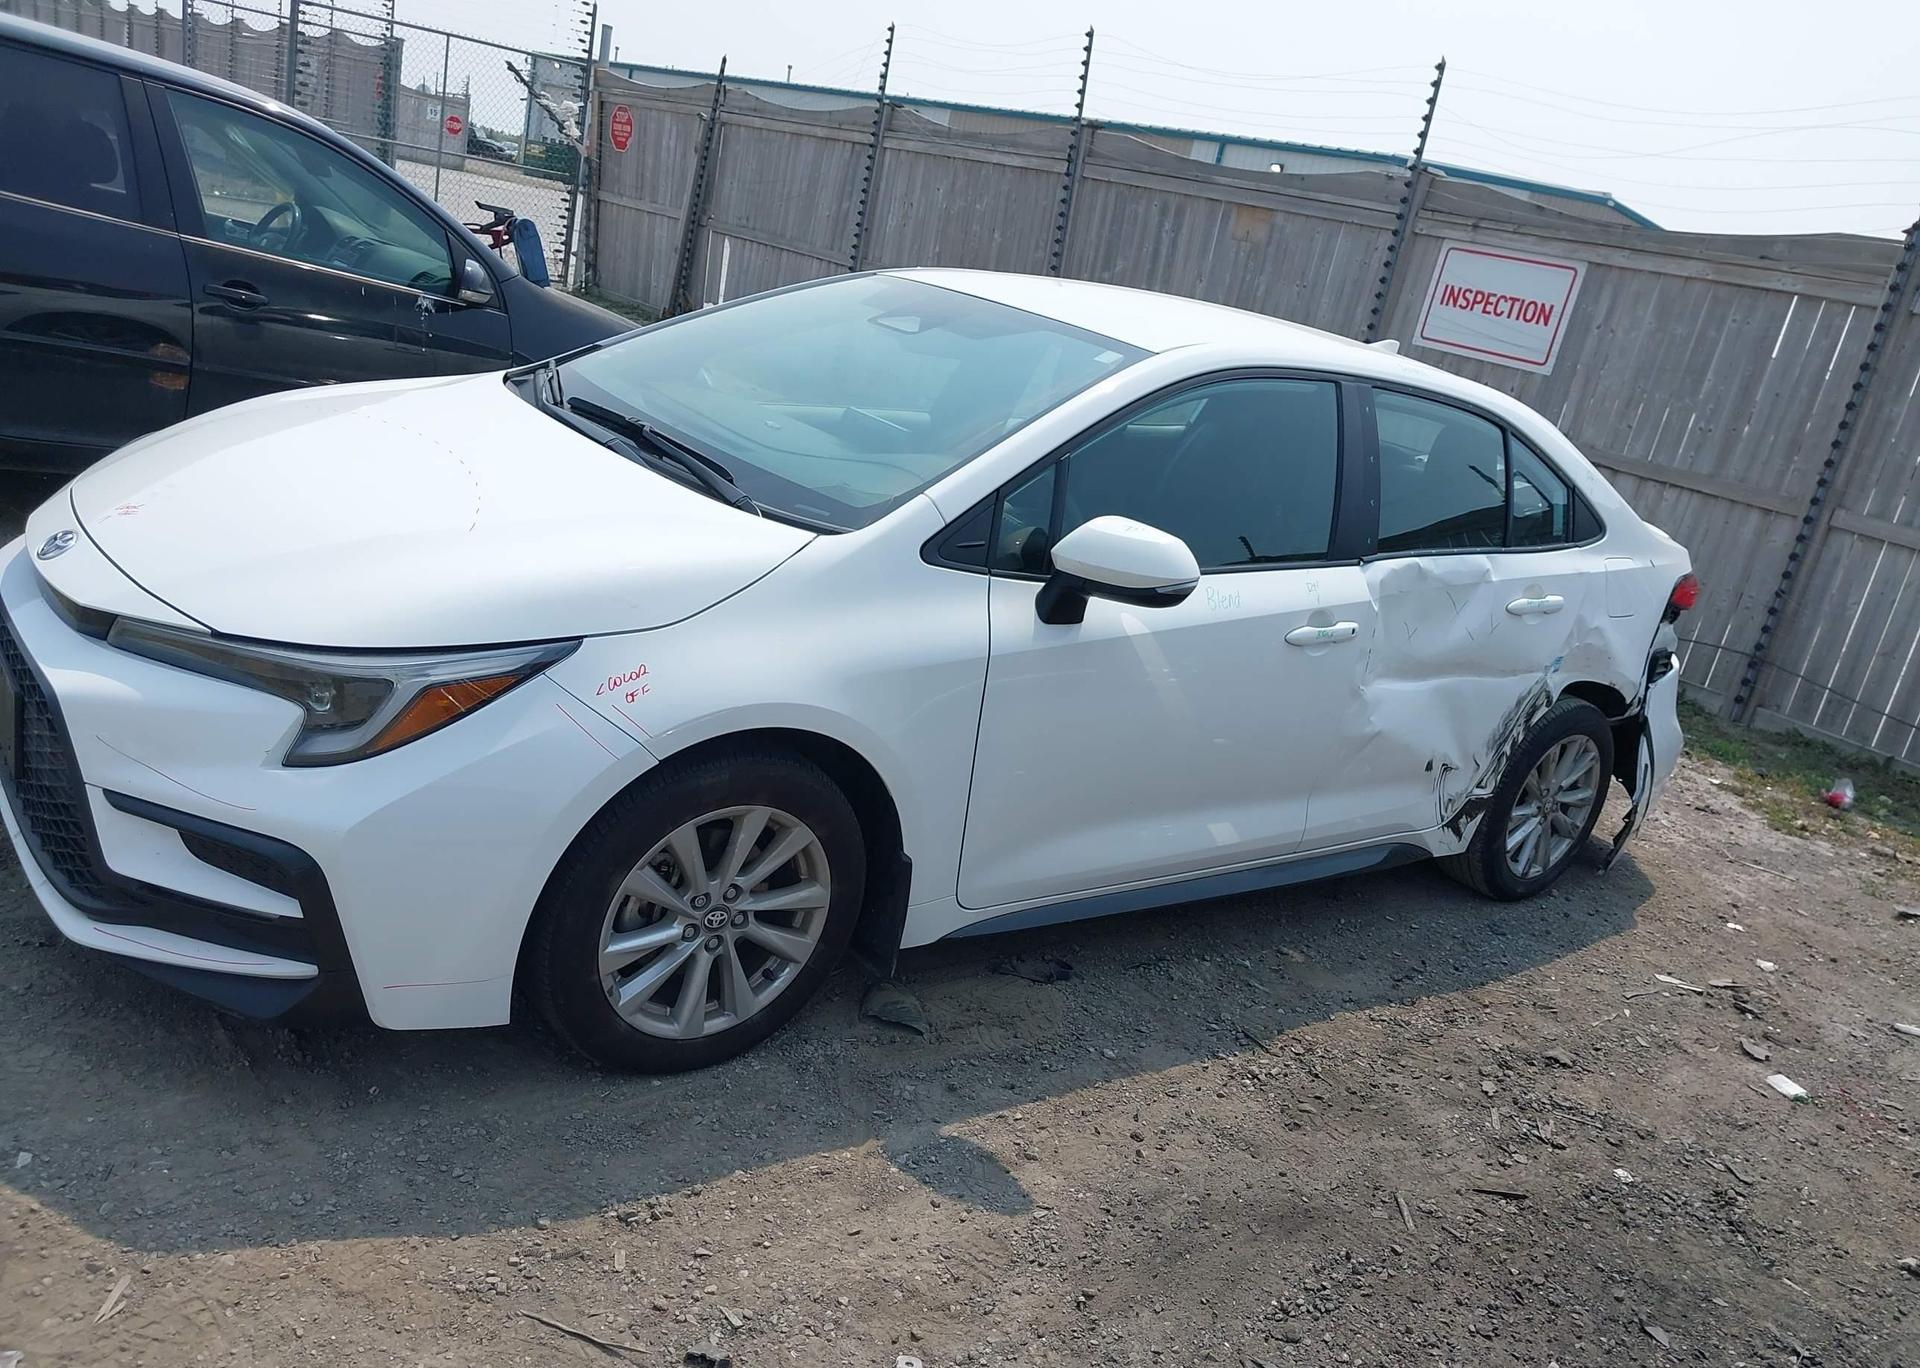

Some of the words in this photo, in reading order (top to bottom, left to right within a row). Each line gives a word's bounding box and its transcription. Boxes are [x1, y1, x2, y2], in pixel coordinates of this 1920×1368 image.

[446, 120, 462, 130] STOP
[1440, 284, 1554, 327] INSPECTION
[1206, 586, 1240, 610] Blend
